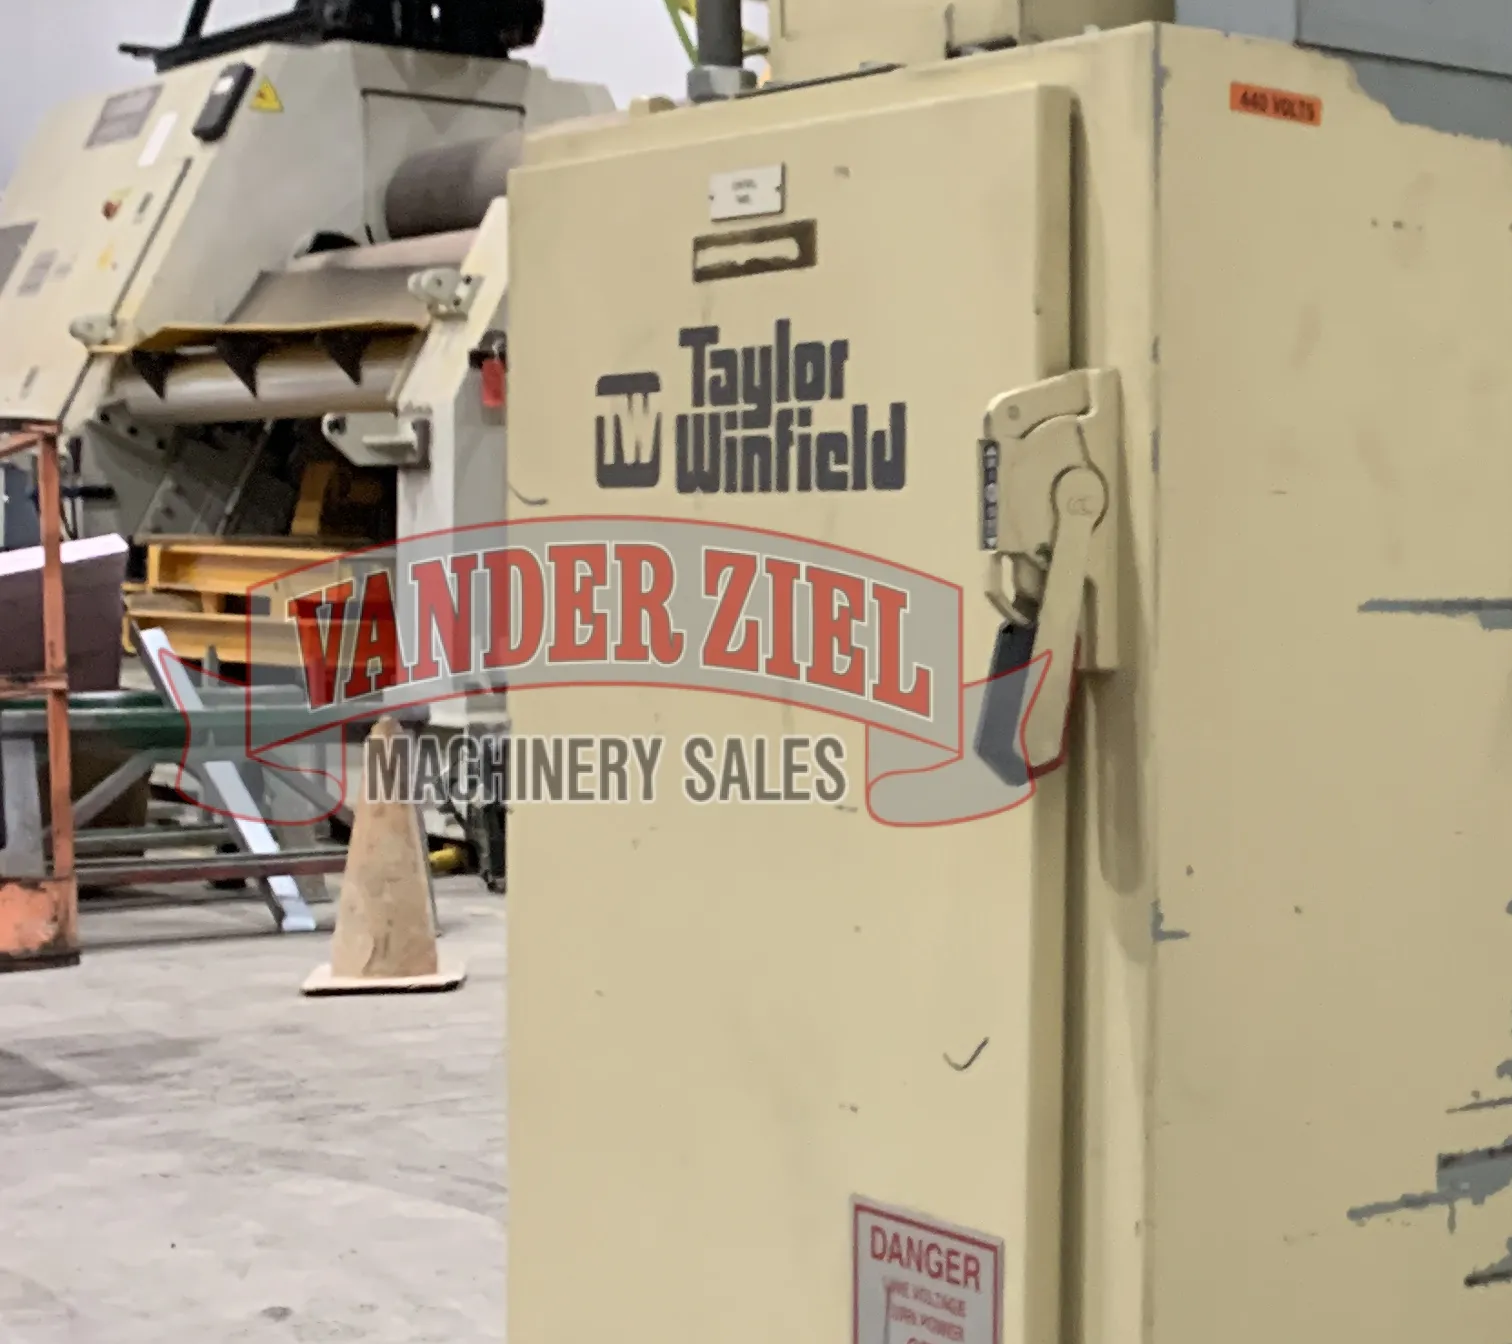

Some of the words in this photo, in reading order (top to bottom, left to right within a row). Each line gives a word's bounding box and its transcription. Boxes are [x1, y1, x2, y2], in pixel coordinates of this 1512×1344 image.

[1271, 92, 1316, 122] VOLTS
[679, 317, 849, 419] Taylor
[675, 401, 907, 494] Winfield
[869, 1225, 981, 1293] DANGER
